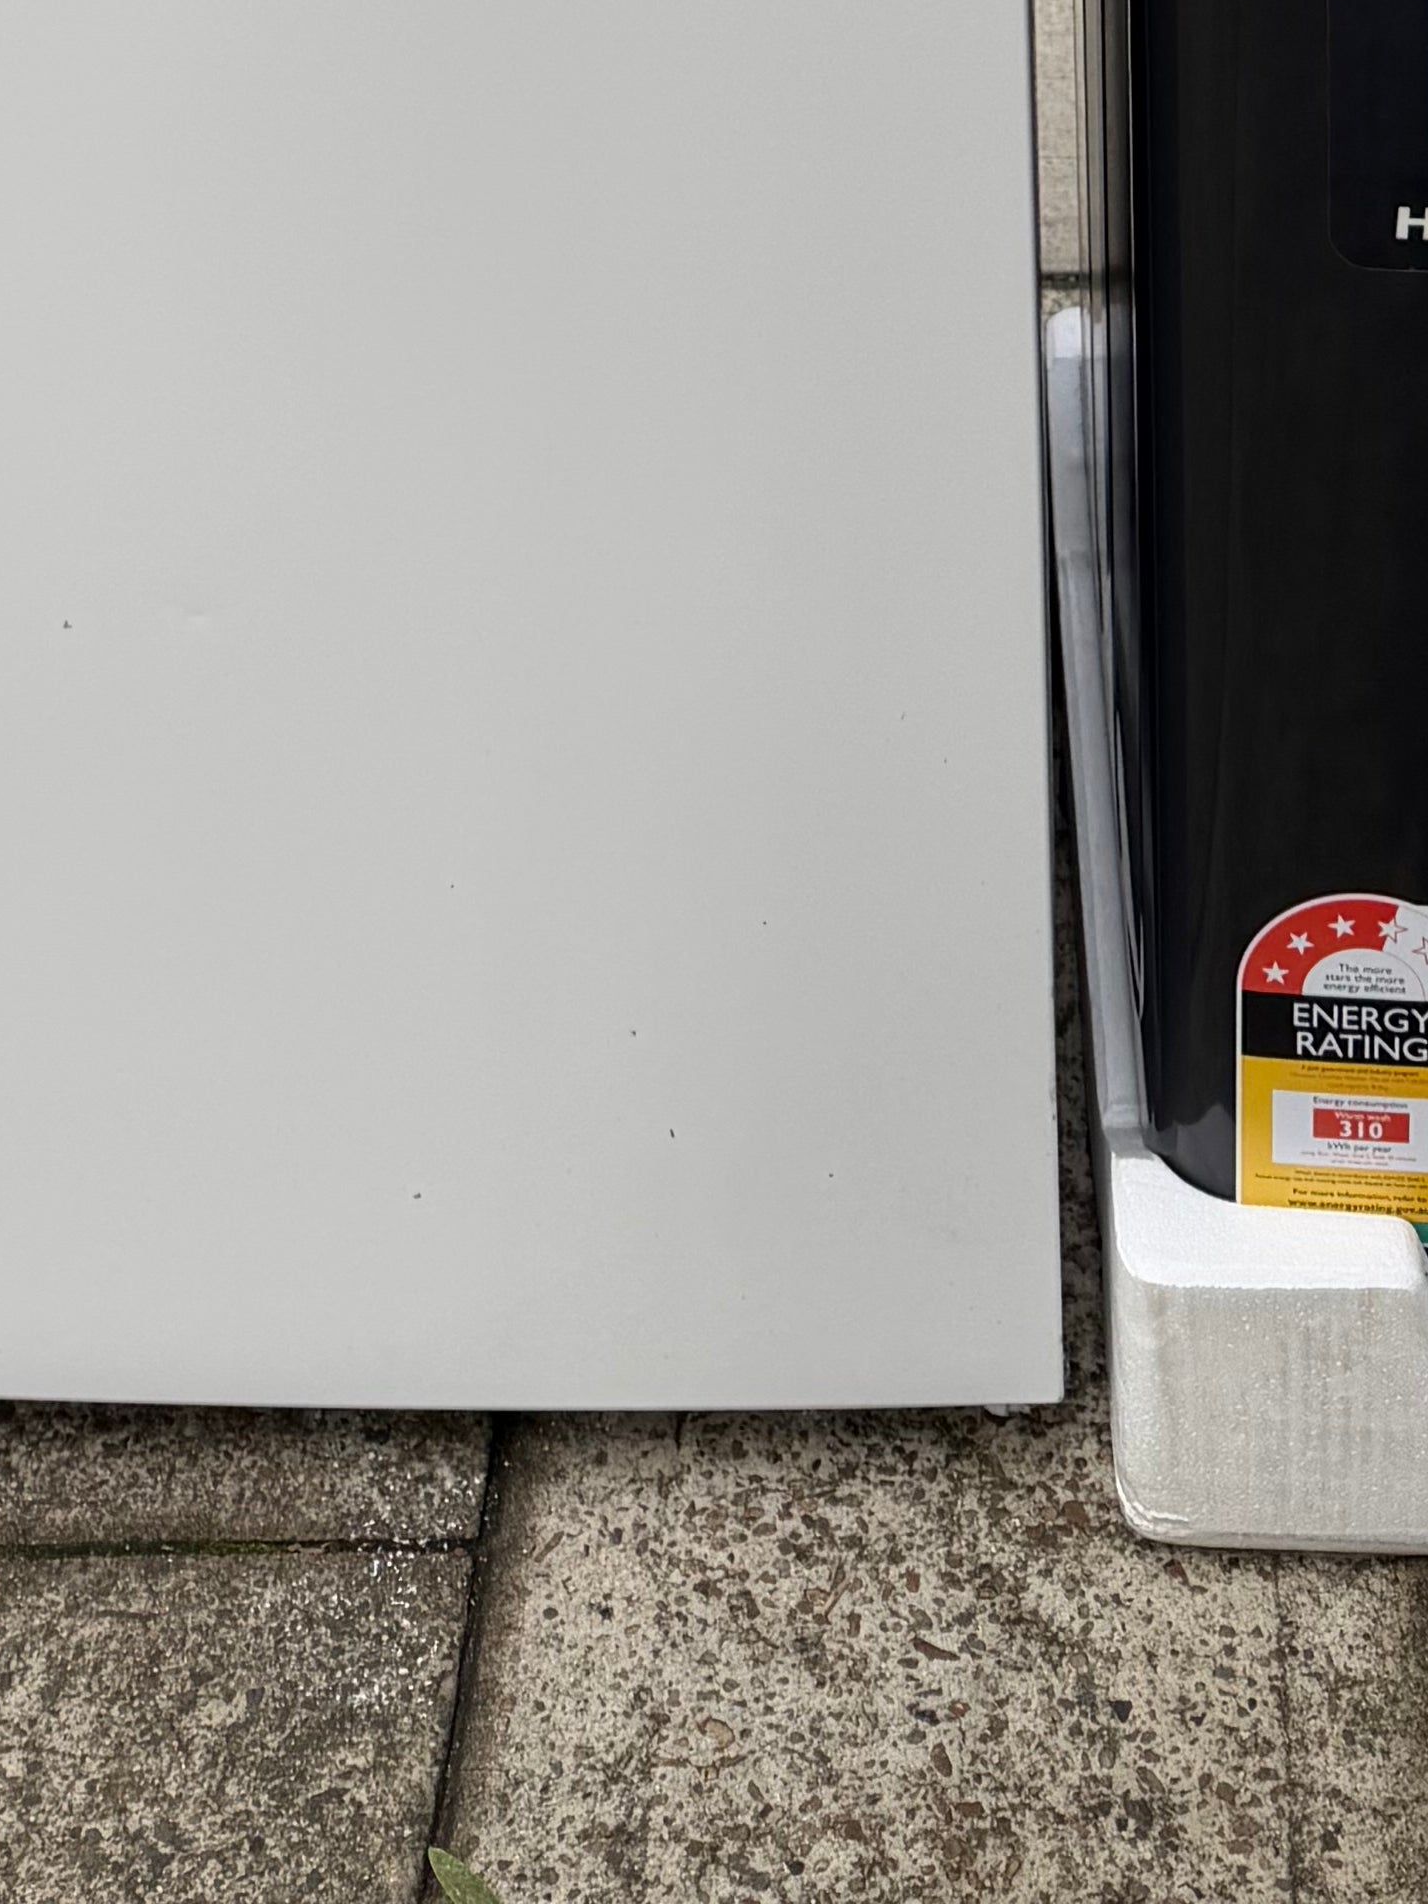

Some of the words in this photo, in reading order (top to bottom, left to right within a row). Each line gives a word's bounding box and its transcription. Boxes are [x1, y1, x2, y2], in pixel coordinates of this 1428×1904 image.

[1339, 963, 1359, 973] The
[1363, 966, 1392, 975] more
[1325, 974, 1351, 983] stars
[1354, 974, 1372, 984] the
[1375, 977, 1405, 985] more
[1323, 983, 1360, 994] energy
[1296, 1030, 1428, 1062] RATING
[1313, 1096, 1345, 1108] Energy
[1347, 1098, 1408, 1110] consumption
[1340, 1120, 1383, 1139] 310
[1372, 1144, 1392, 1155] year
